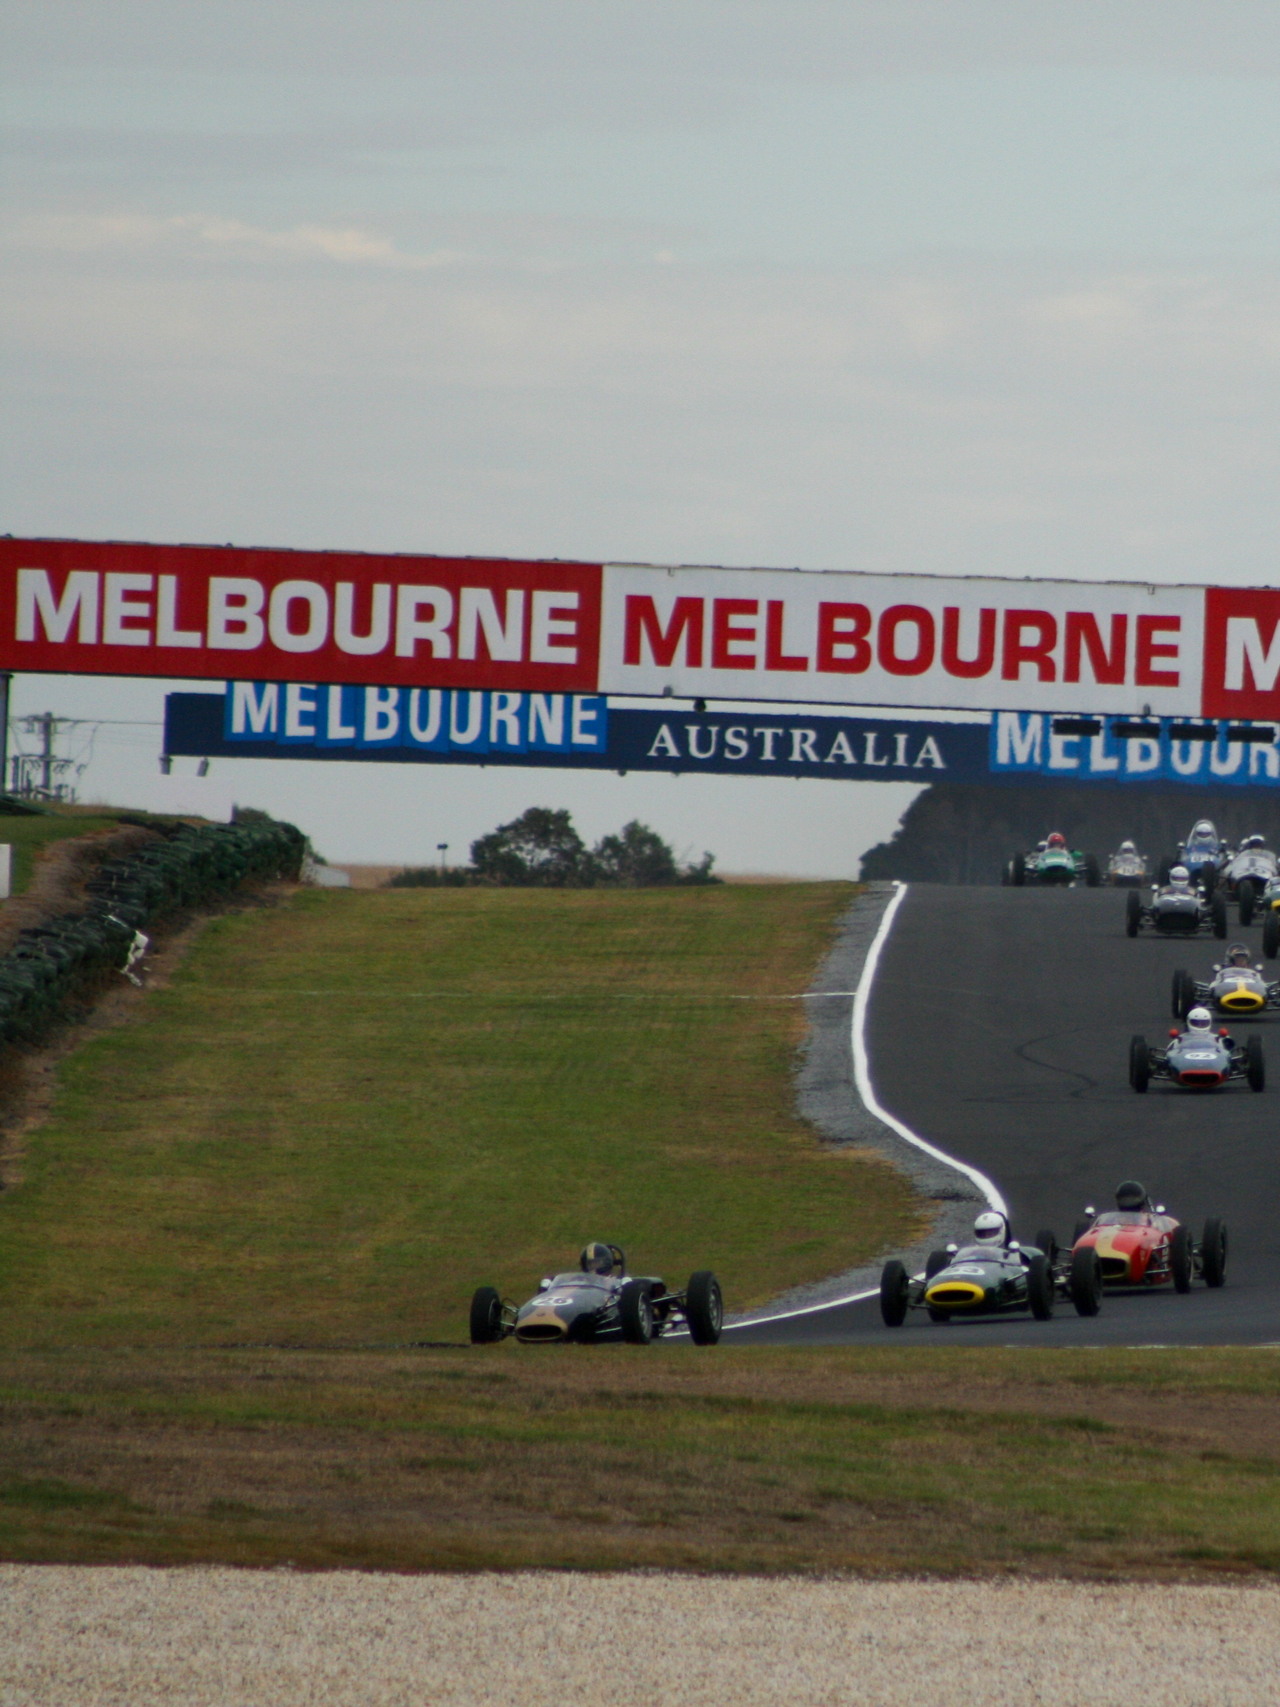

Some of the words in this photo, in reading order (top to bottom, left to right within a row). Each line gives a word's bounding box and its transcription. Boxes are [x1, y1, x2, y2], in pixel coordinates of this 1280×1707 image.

[14, 567, 579, 665] MELBOURNE
[622, 594, 1181, 688] MELBOURNE
[231, 681, 598, 746] MELBOURNE
[647, 723, 946, 769] AUSTRALIA
[536, 1296, 571, 1305] 26
